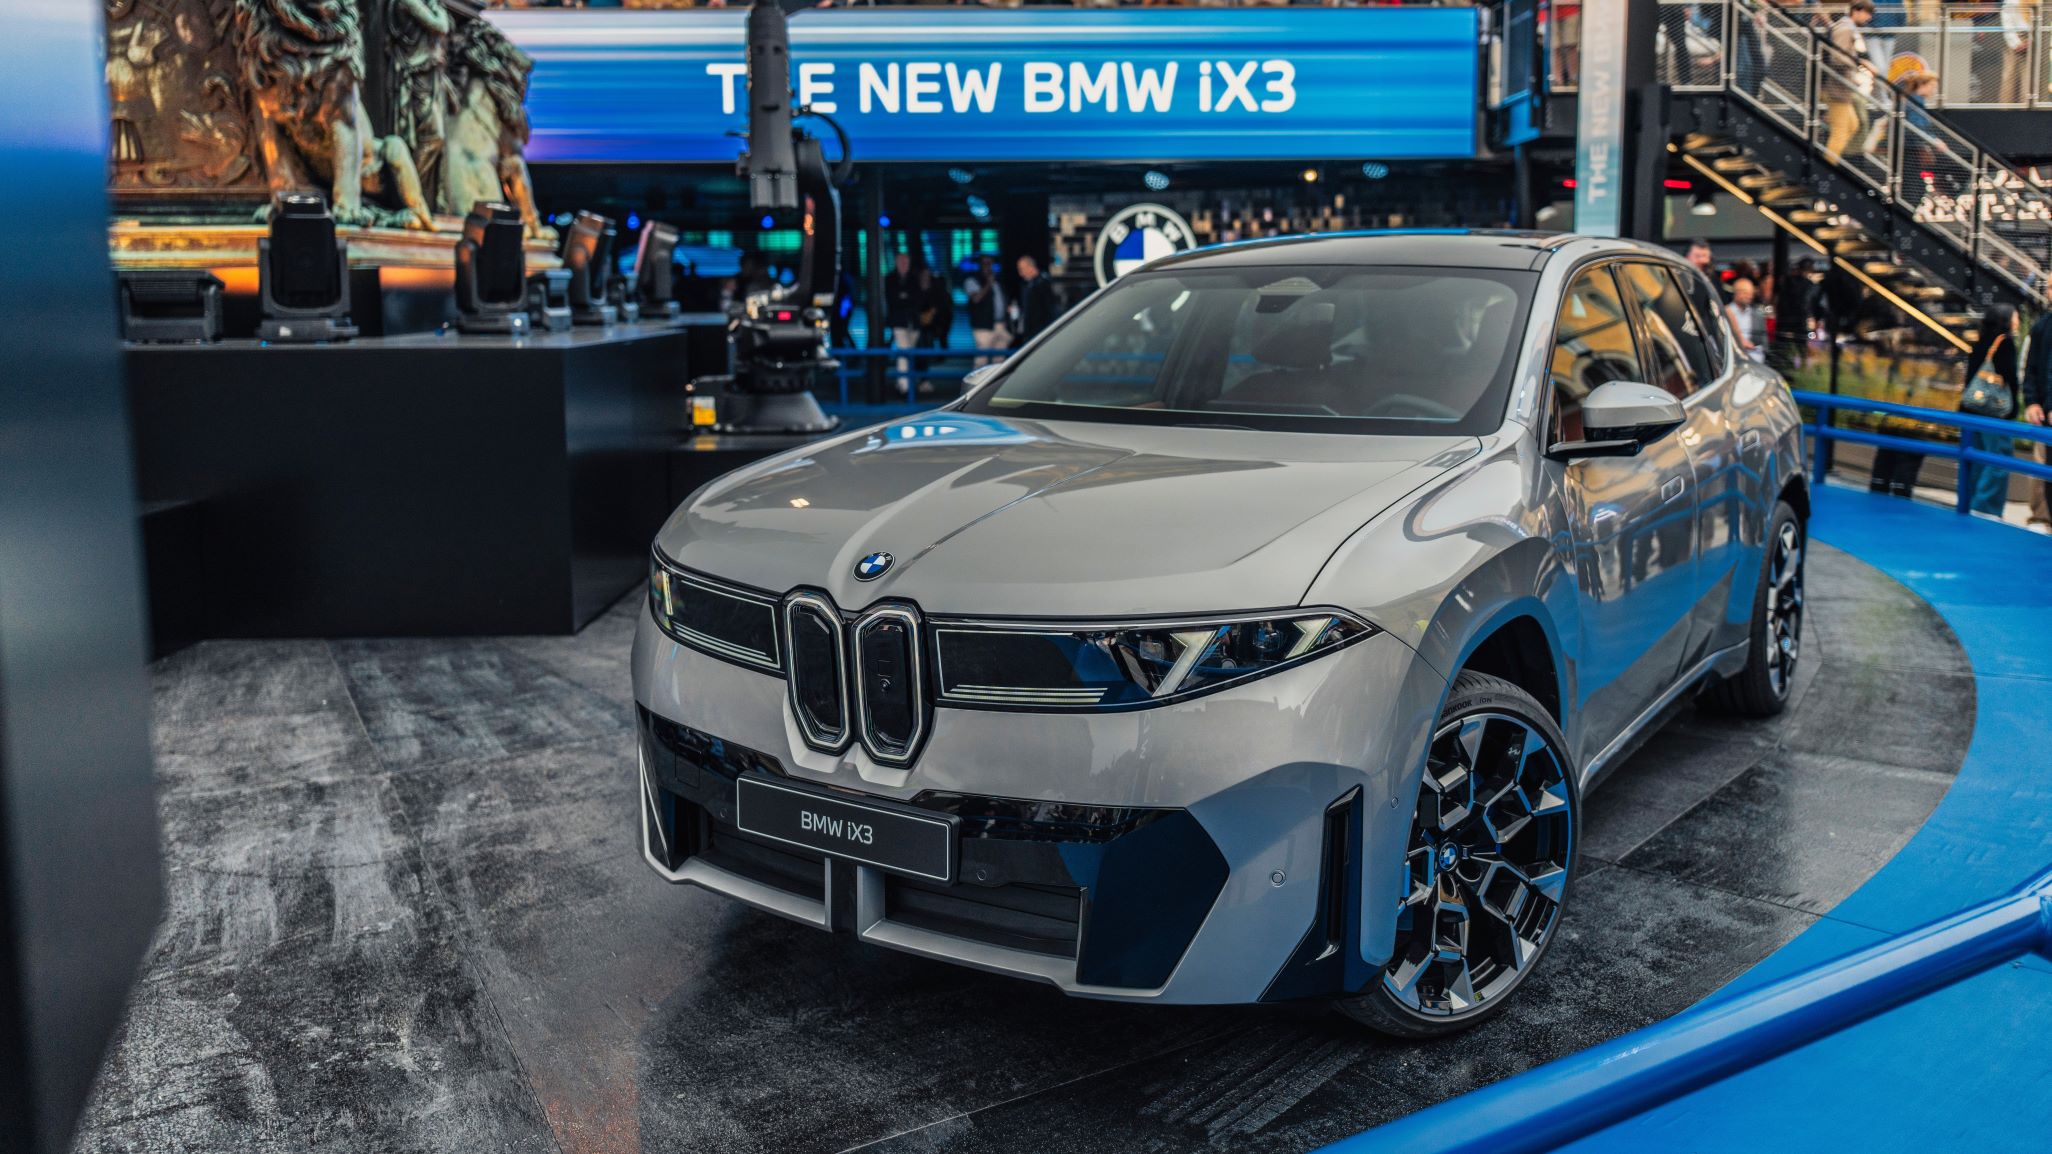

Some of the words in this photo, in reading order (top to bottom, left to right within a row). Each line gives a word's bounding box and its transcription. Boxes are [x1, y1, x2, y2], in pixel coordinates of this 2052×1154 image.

[706, 62, 837, 115] TE
[859, 62, 1002, 114] NEW
[1024, 61, 1179, 113] BMW
[1199, 60, 1296, 113] iX3
[1591, 72, 1611, 137] NEW
[1587, 143, 1609, 205] THE
[1109, 212, 1183, 244] BMW
[801, 810, 843, 838] BMW
[847, 821, 873, 845] iX3
